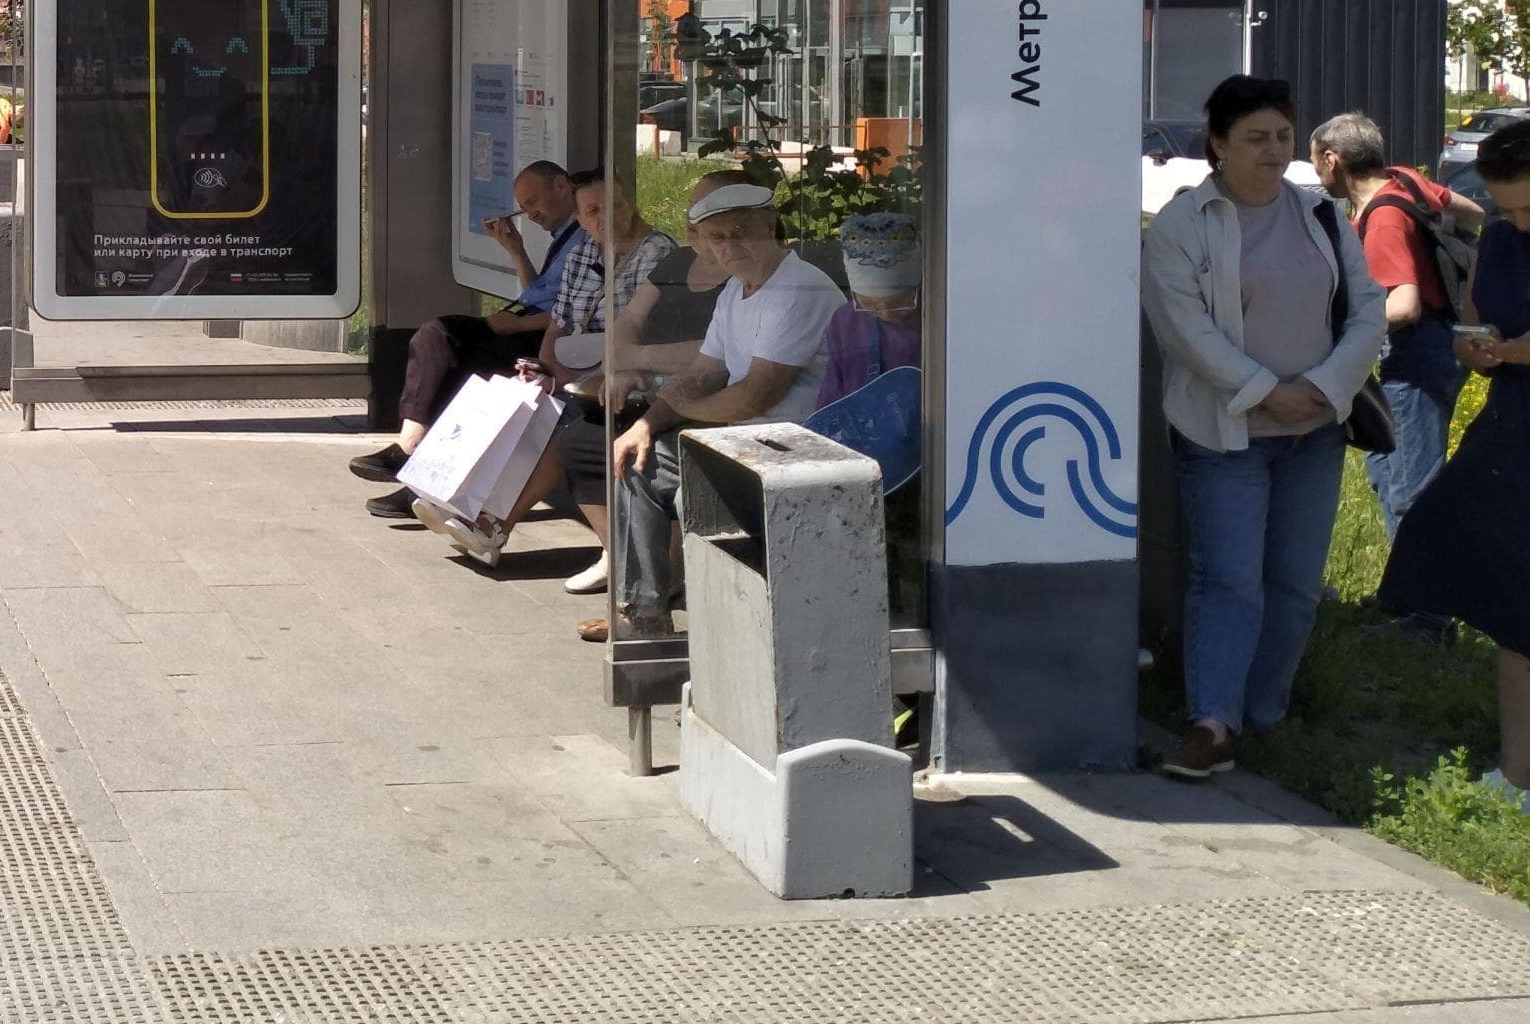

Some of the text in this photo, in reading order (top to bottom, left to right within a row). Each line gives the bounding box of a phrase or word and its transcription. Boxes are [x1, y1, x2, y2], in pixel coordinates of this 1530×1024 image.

[93, 233, 261, 246] Прикладывайте свой билет
[93, 246, 293, 259] или карту при входе в транспорт
